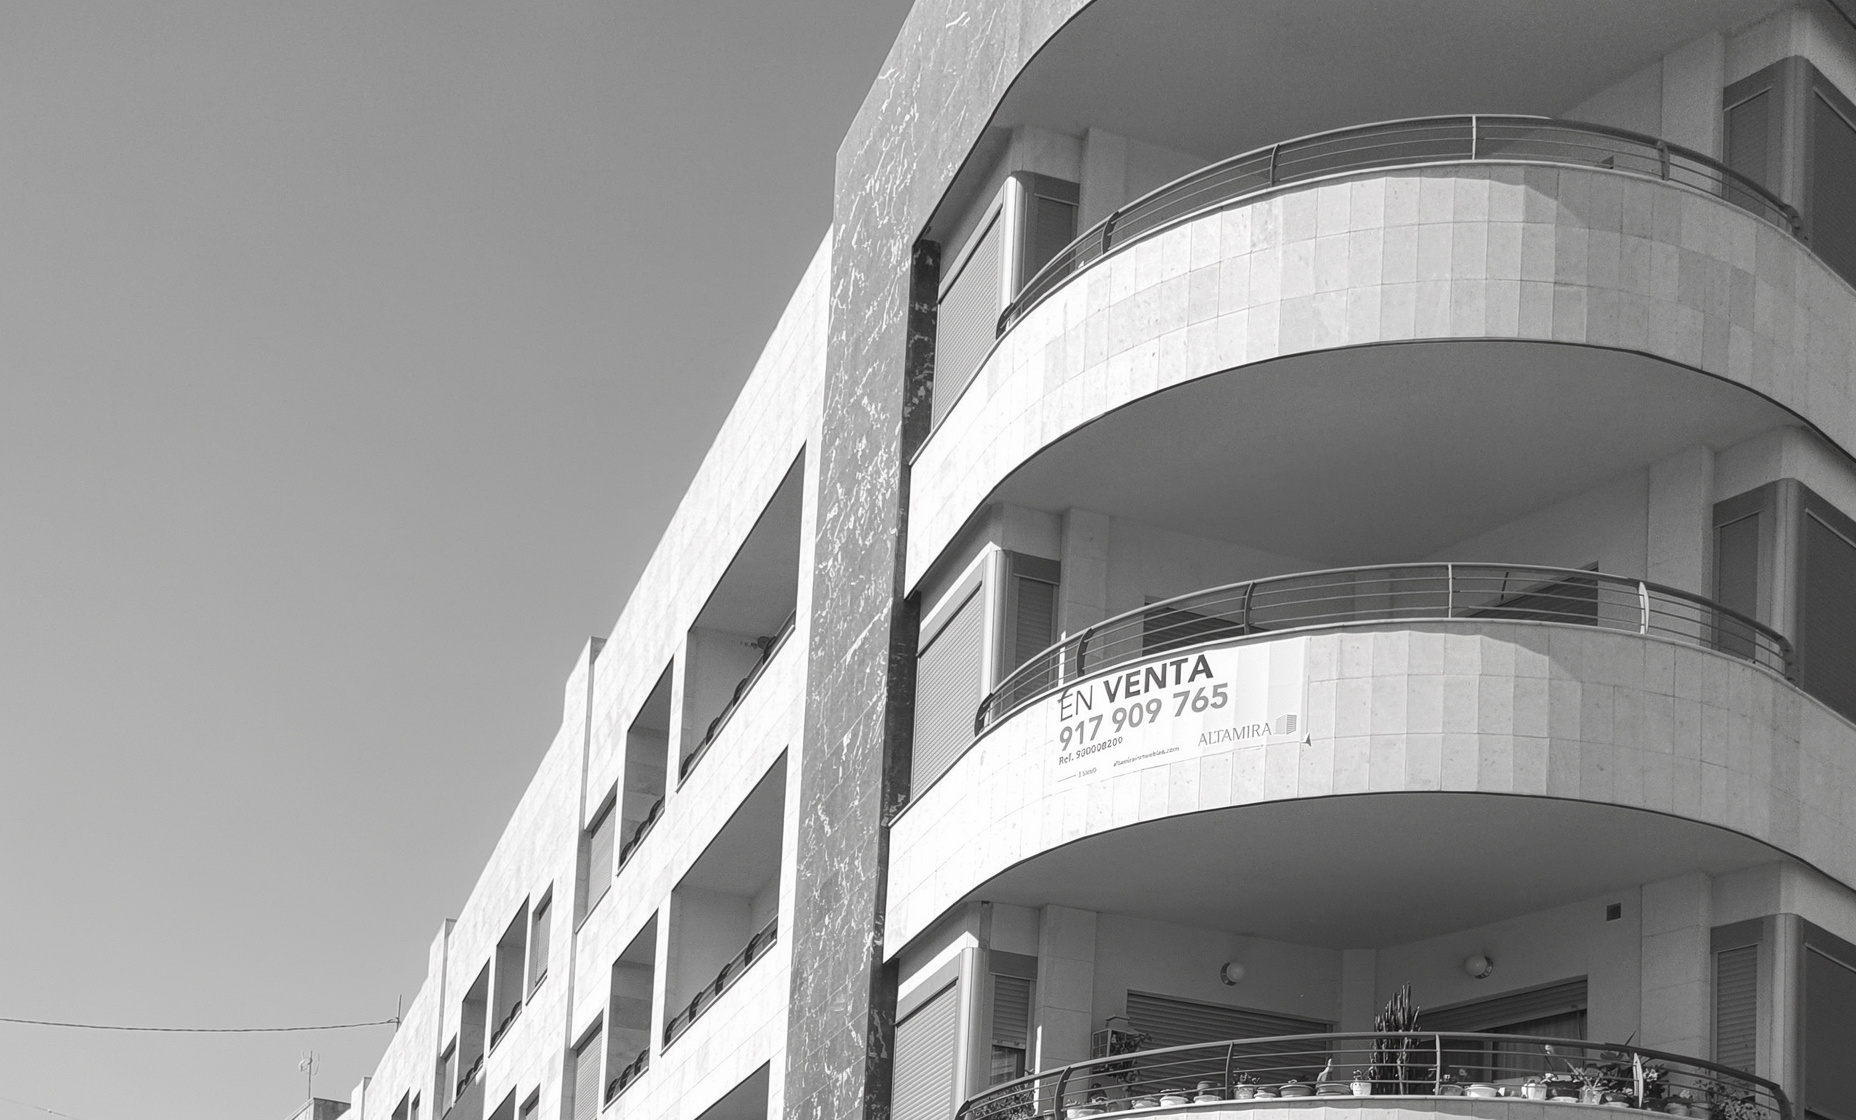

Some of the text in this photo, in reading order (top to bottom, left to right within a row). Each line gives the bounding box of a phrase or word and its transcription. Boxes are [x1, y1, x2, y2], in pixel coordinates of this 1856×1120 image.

[1059, 682, 1229, 752] 917 909 765
[1060, 654, 1214, 722] EN VENTA
[1198, 722, 1272, 747] ALTAMIRA
